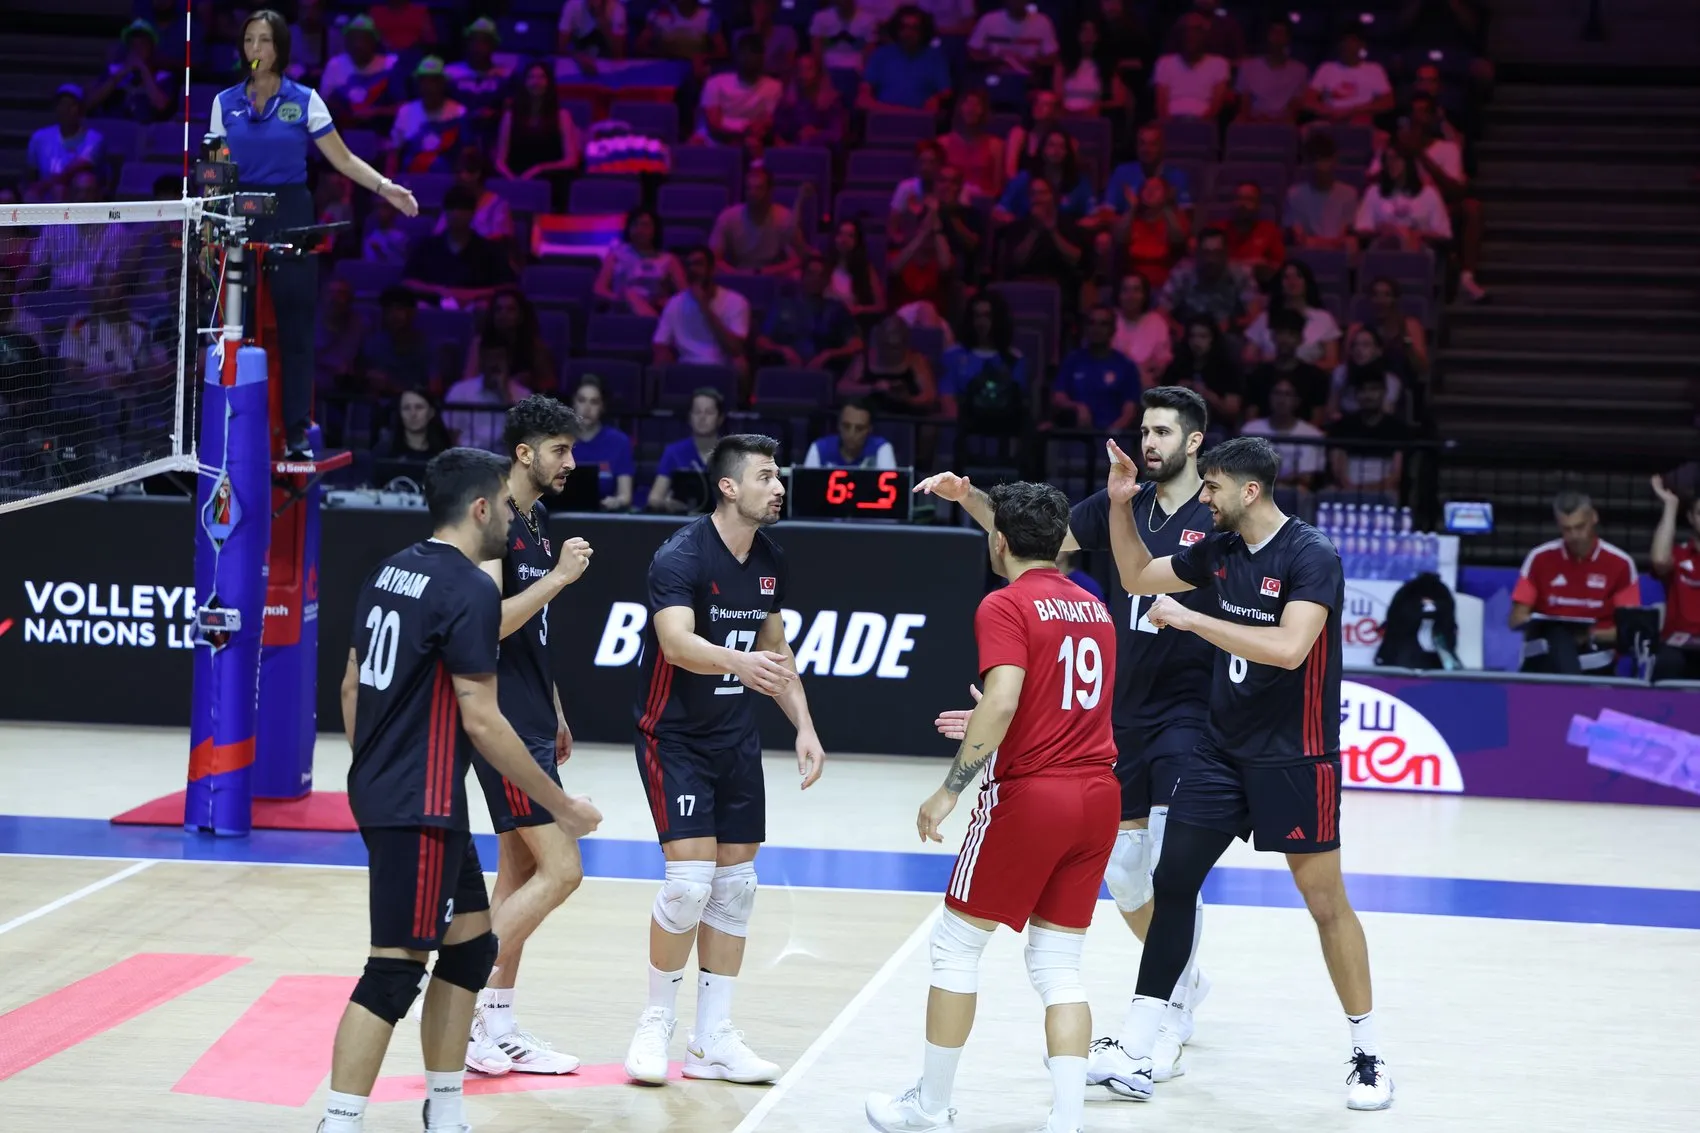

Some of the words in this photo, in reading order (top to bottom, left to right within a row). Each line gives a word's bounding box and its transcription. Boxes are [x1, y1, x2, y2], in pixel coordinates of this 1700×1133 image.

[24, 617, 156, 648] NATIONS
[359, 605, 400, 691] 20
[1057, 635, 1103, 710] 19
[1341, 736, 1441, 786] ten
[676, 794, 696, 817] 17
